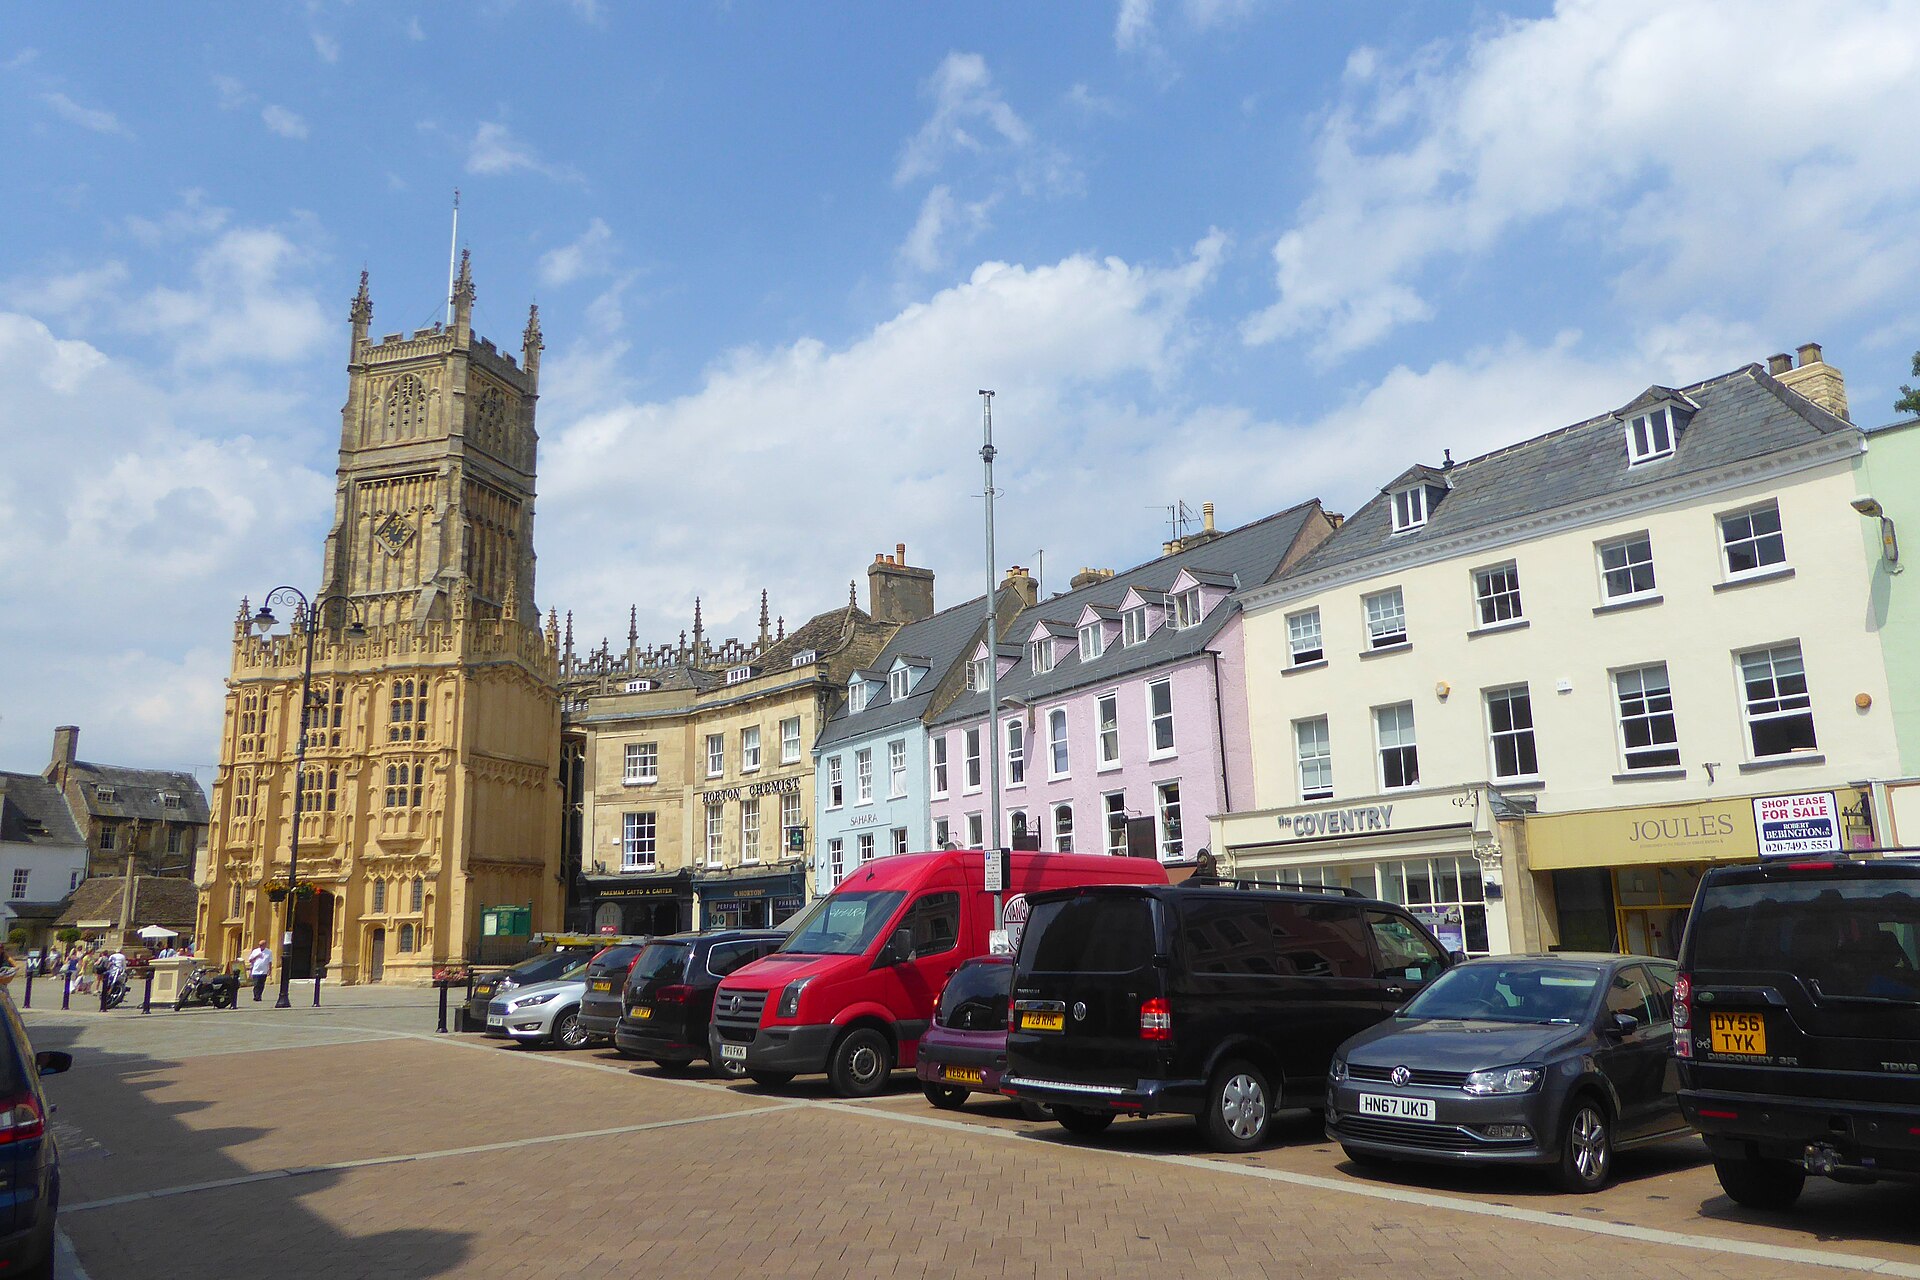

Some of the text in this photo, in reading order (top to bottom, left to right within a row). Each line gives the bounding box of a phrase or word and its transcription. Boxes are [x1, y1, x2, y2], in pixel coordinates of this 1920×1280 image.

[702, 777, 801, 802] HORTON CHEMIST
[1761, 796, 1826, 809] SHOP LEASE
[850, 813, 878, 827] SAHARA
[1762, 806, 1828, 820] FOR SALE
[1277, 804, 1393, 837] the COVENTRY
[1629, 813, 1734, 842] JOULES
[1765, 827, 1822, 839] BEBINGTON
[1765, 840, 1833, 852] 020-7493 5551
[1027, 1013, 1040, 1025] T28
[1715, 1014, 1760, 1031] DY56
[1722, 1034, 1755, 1051] TYK
[1707, 1053, 1774, 1064] DISCOVERY
[1365, 1097, 1428, 1117] HN67 UKD
